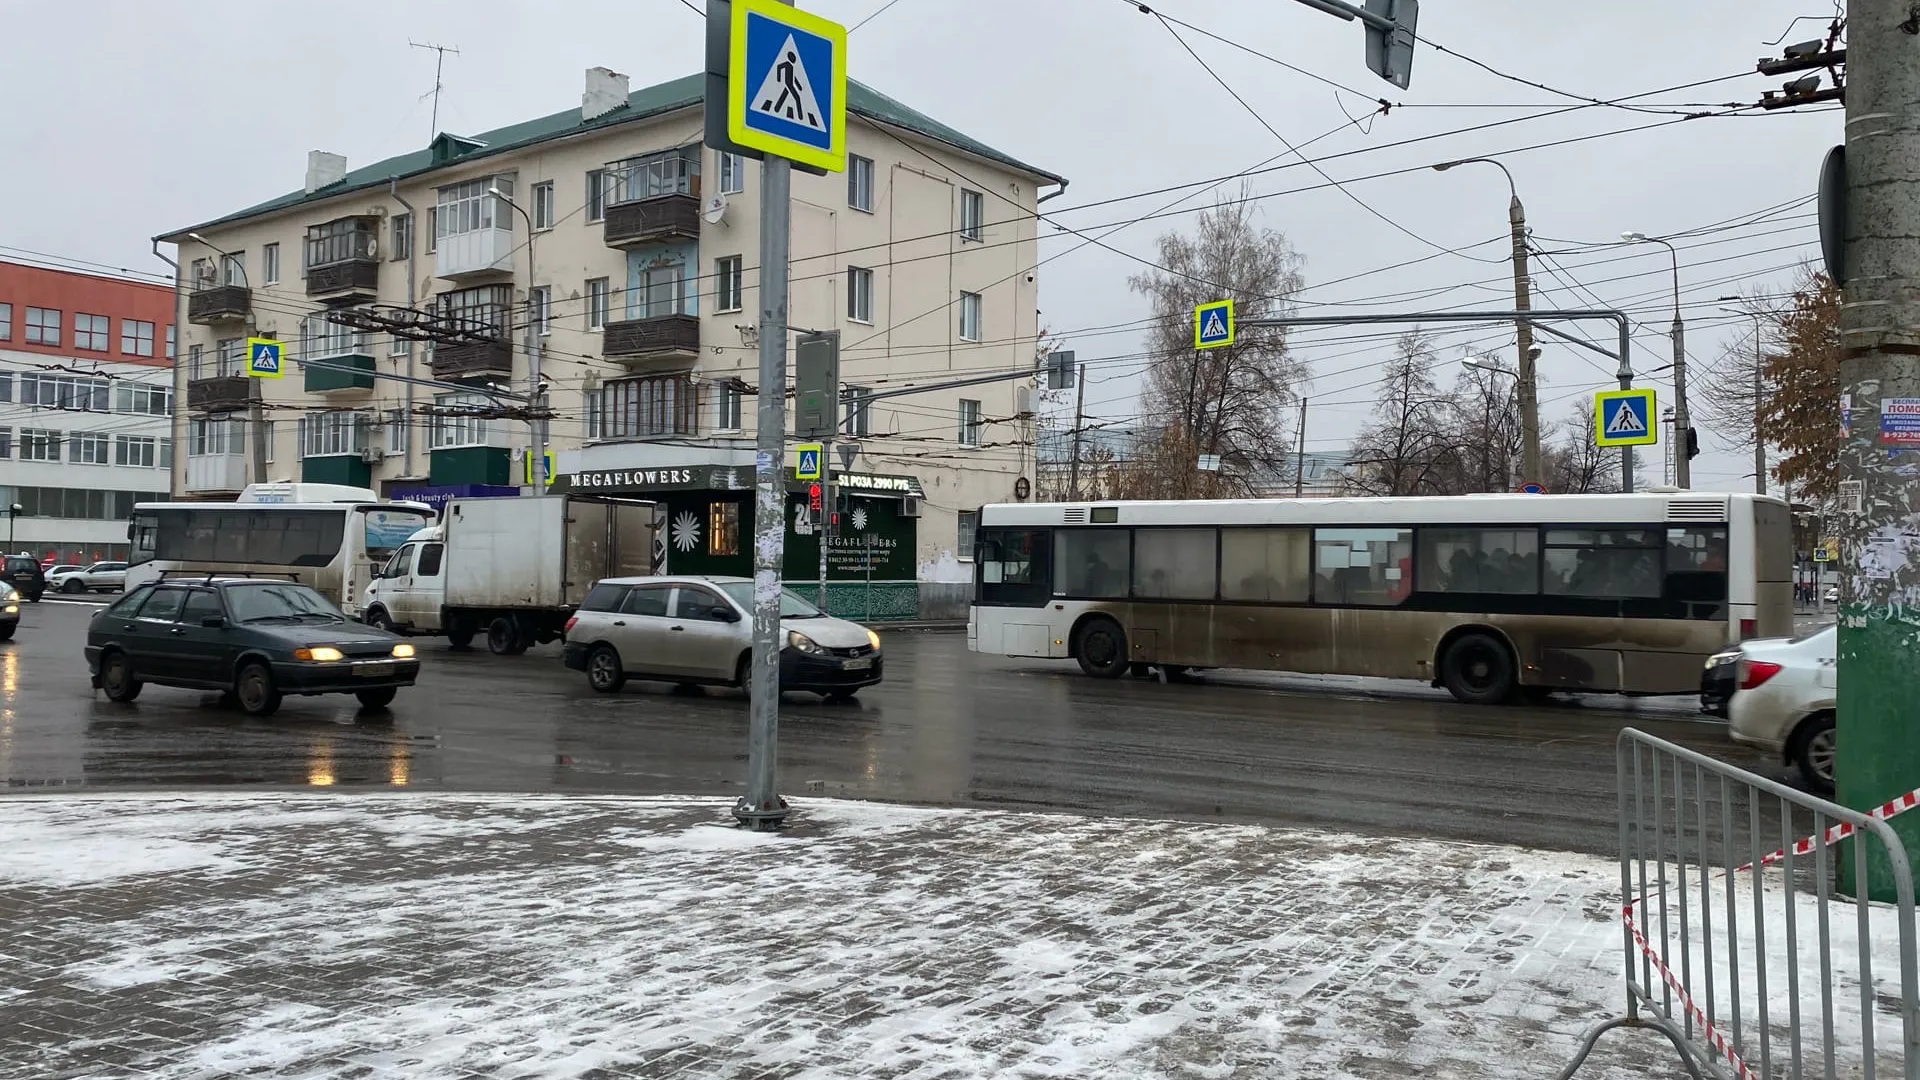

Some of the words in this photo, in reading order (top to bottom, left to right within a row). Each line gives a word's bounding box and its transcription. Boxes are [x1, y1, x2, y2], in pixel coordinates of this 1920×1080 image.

[570, 469, 691, 487] MEGAFLOWERS
[838, 474, 849, 487] 51
[850, 475, 872, 488] РОЗА
[873, 477, 893, 489] 2990
